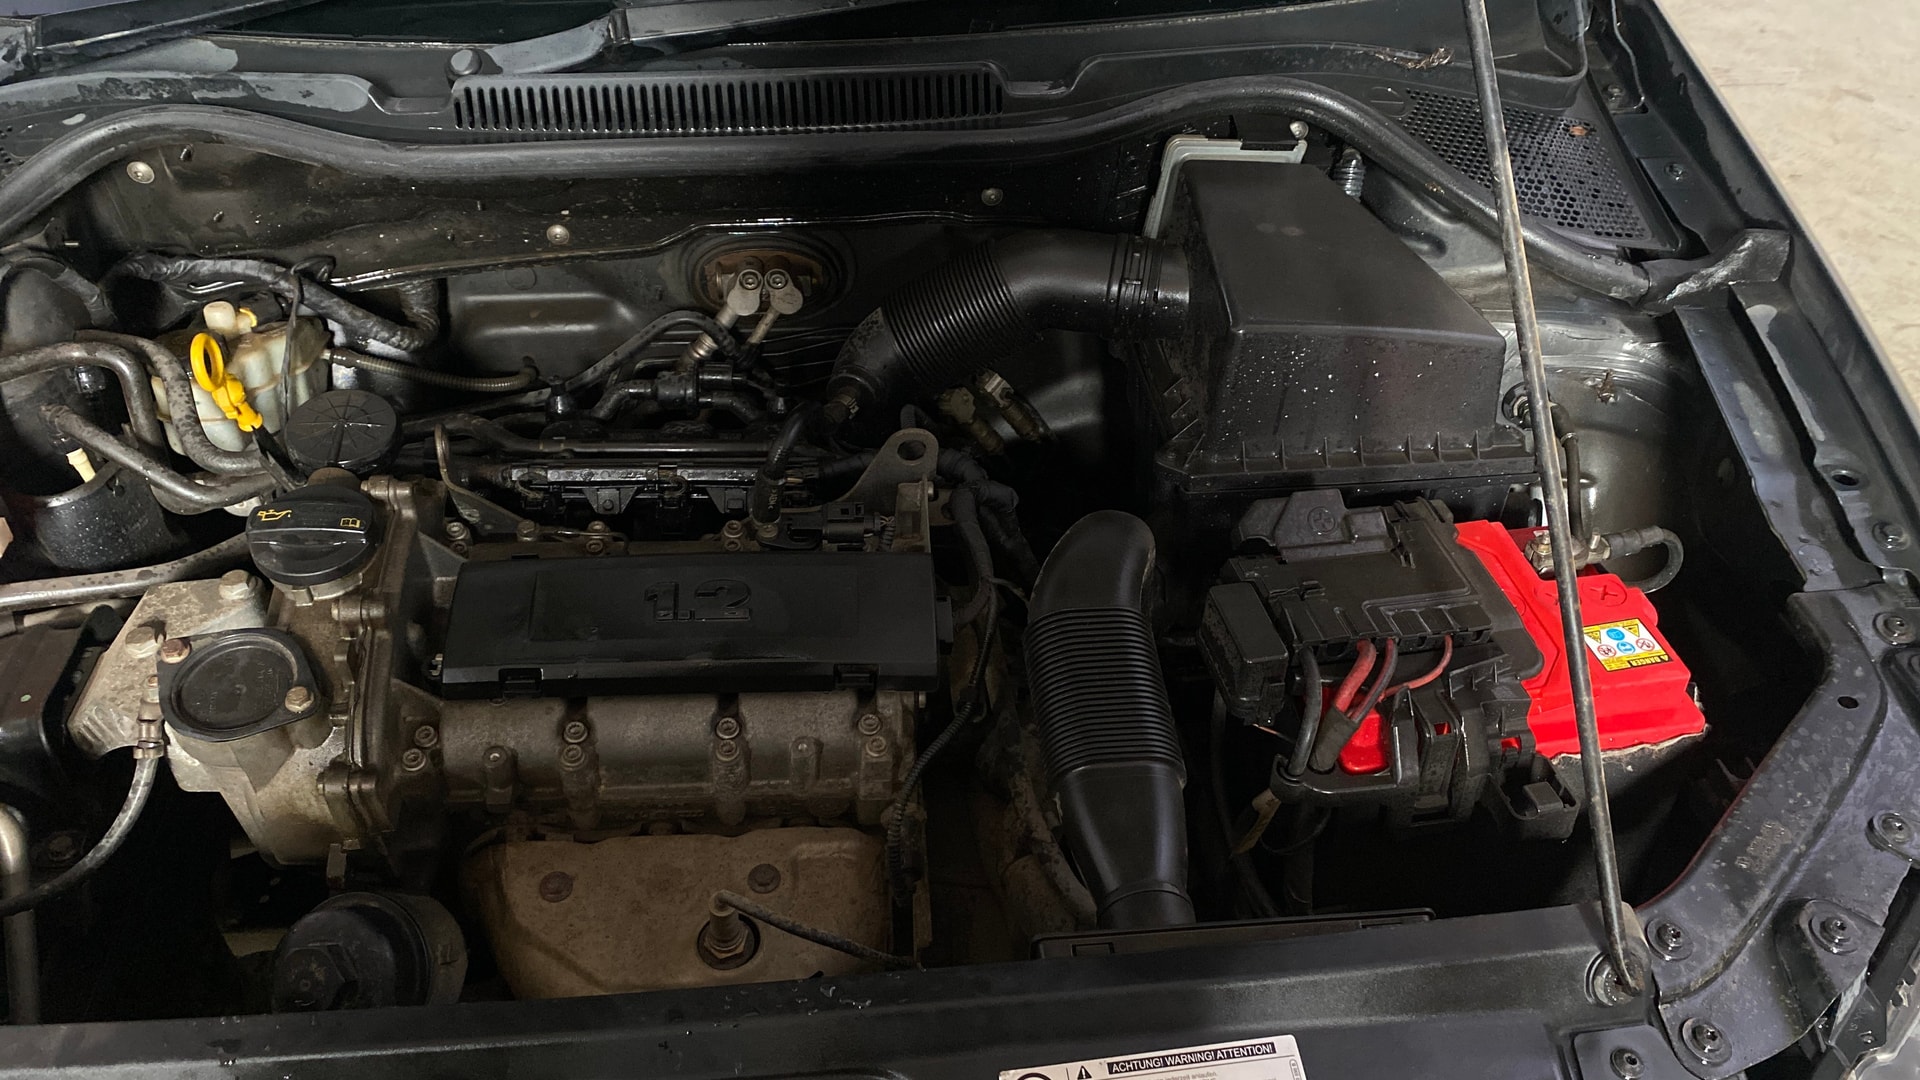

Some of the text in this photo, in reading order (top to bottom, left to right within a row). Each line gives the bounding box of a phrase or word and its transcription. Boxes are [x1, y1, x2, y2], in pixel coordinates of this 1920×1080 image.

[644, 579, 752, 622] 1.2
[1630, 656, 1661, 666] DANGER
[1112, 1043, 1273, 1074] ACHTUNG! WARNING! ATTENTION!
